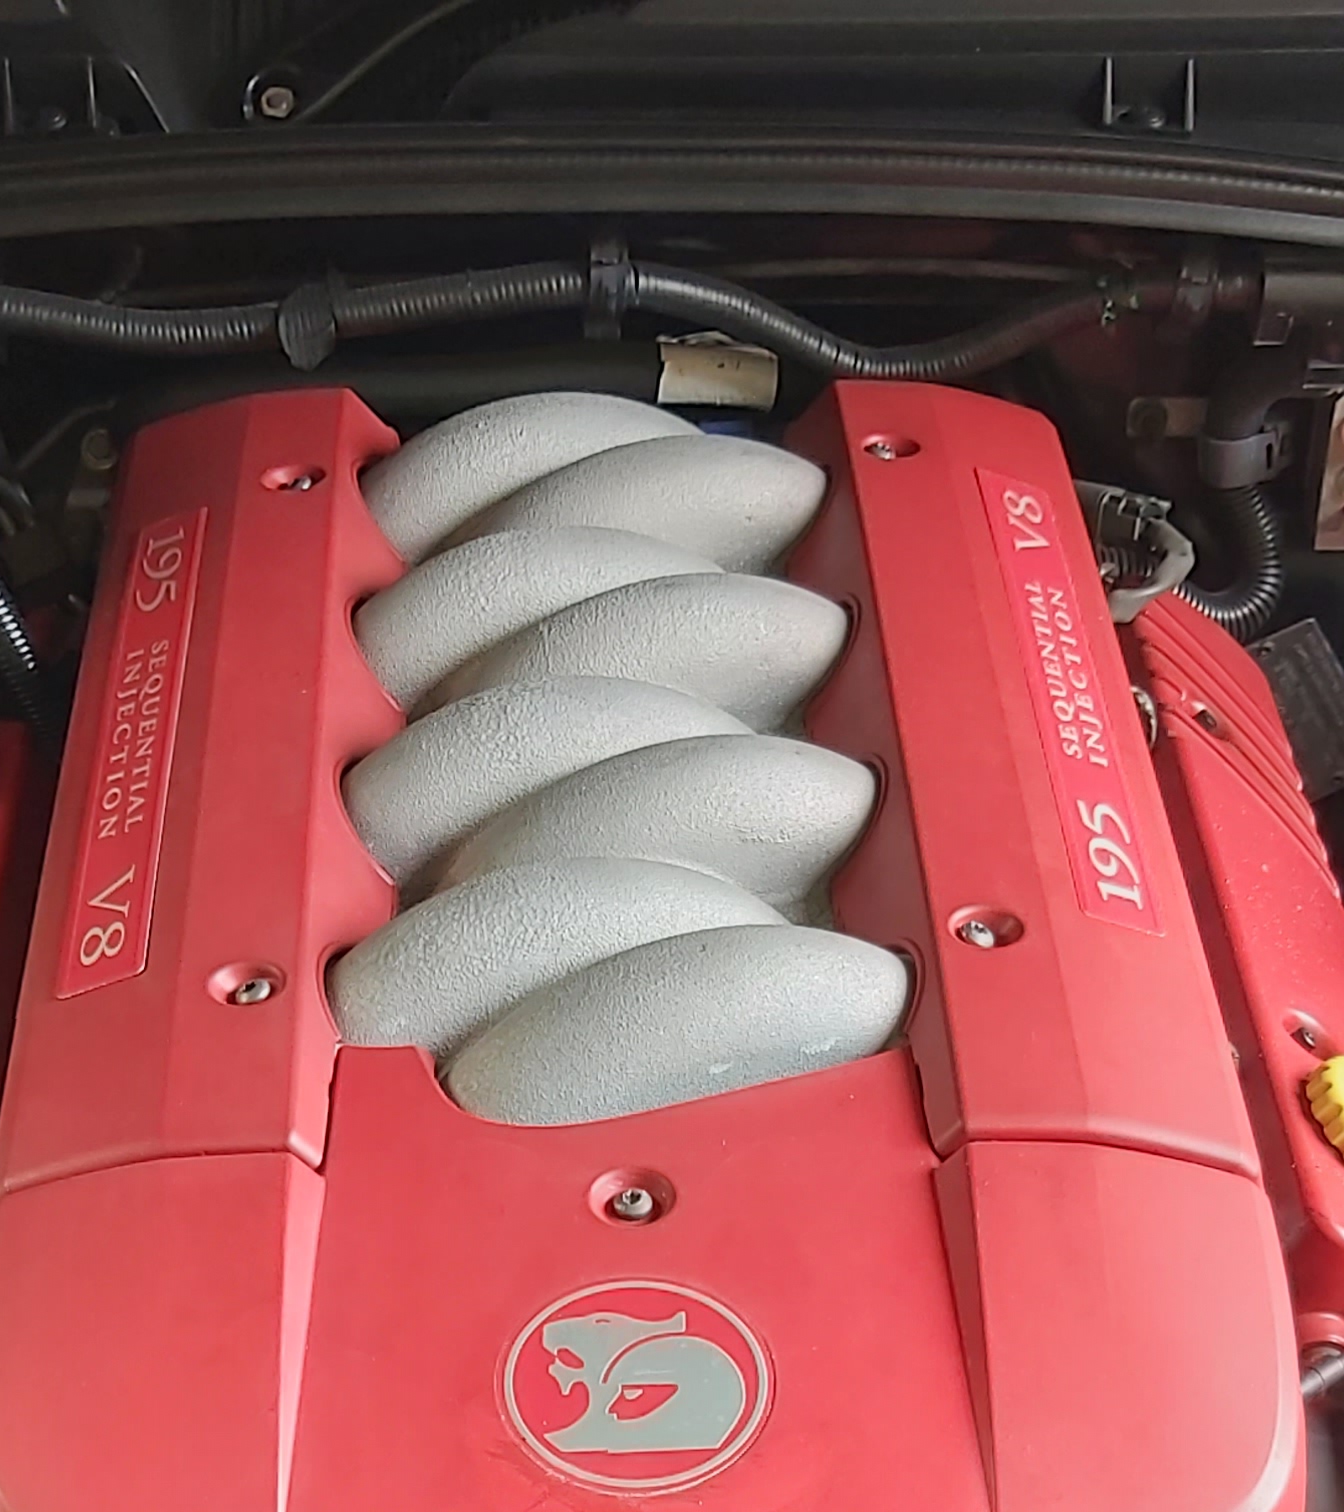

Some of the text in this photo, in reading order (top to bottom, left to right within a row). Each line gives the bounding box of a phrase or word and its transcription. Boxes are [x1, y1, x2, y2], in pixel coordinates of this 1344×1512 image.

[134, 527, 186, 613] 195
[1003, 491, 1051, 553] V8
[123, 639, 169, 834] SEQUENTIAL
[1024, 580, 1084, 761] SEQUENTIAL
[1048, 588, 1108, 768] INJECTION
[96, 649, 144, 840] INJECTION
[79, 864, 135, 967] V8
[1076, 799, 1144, 911] 195
